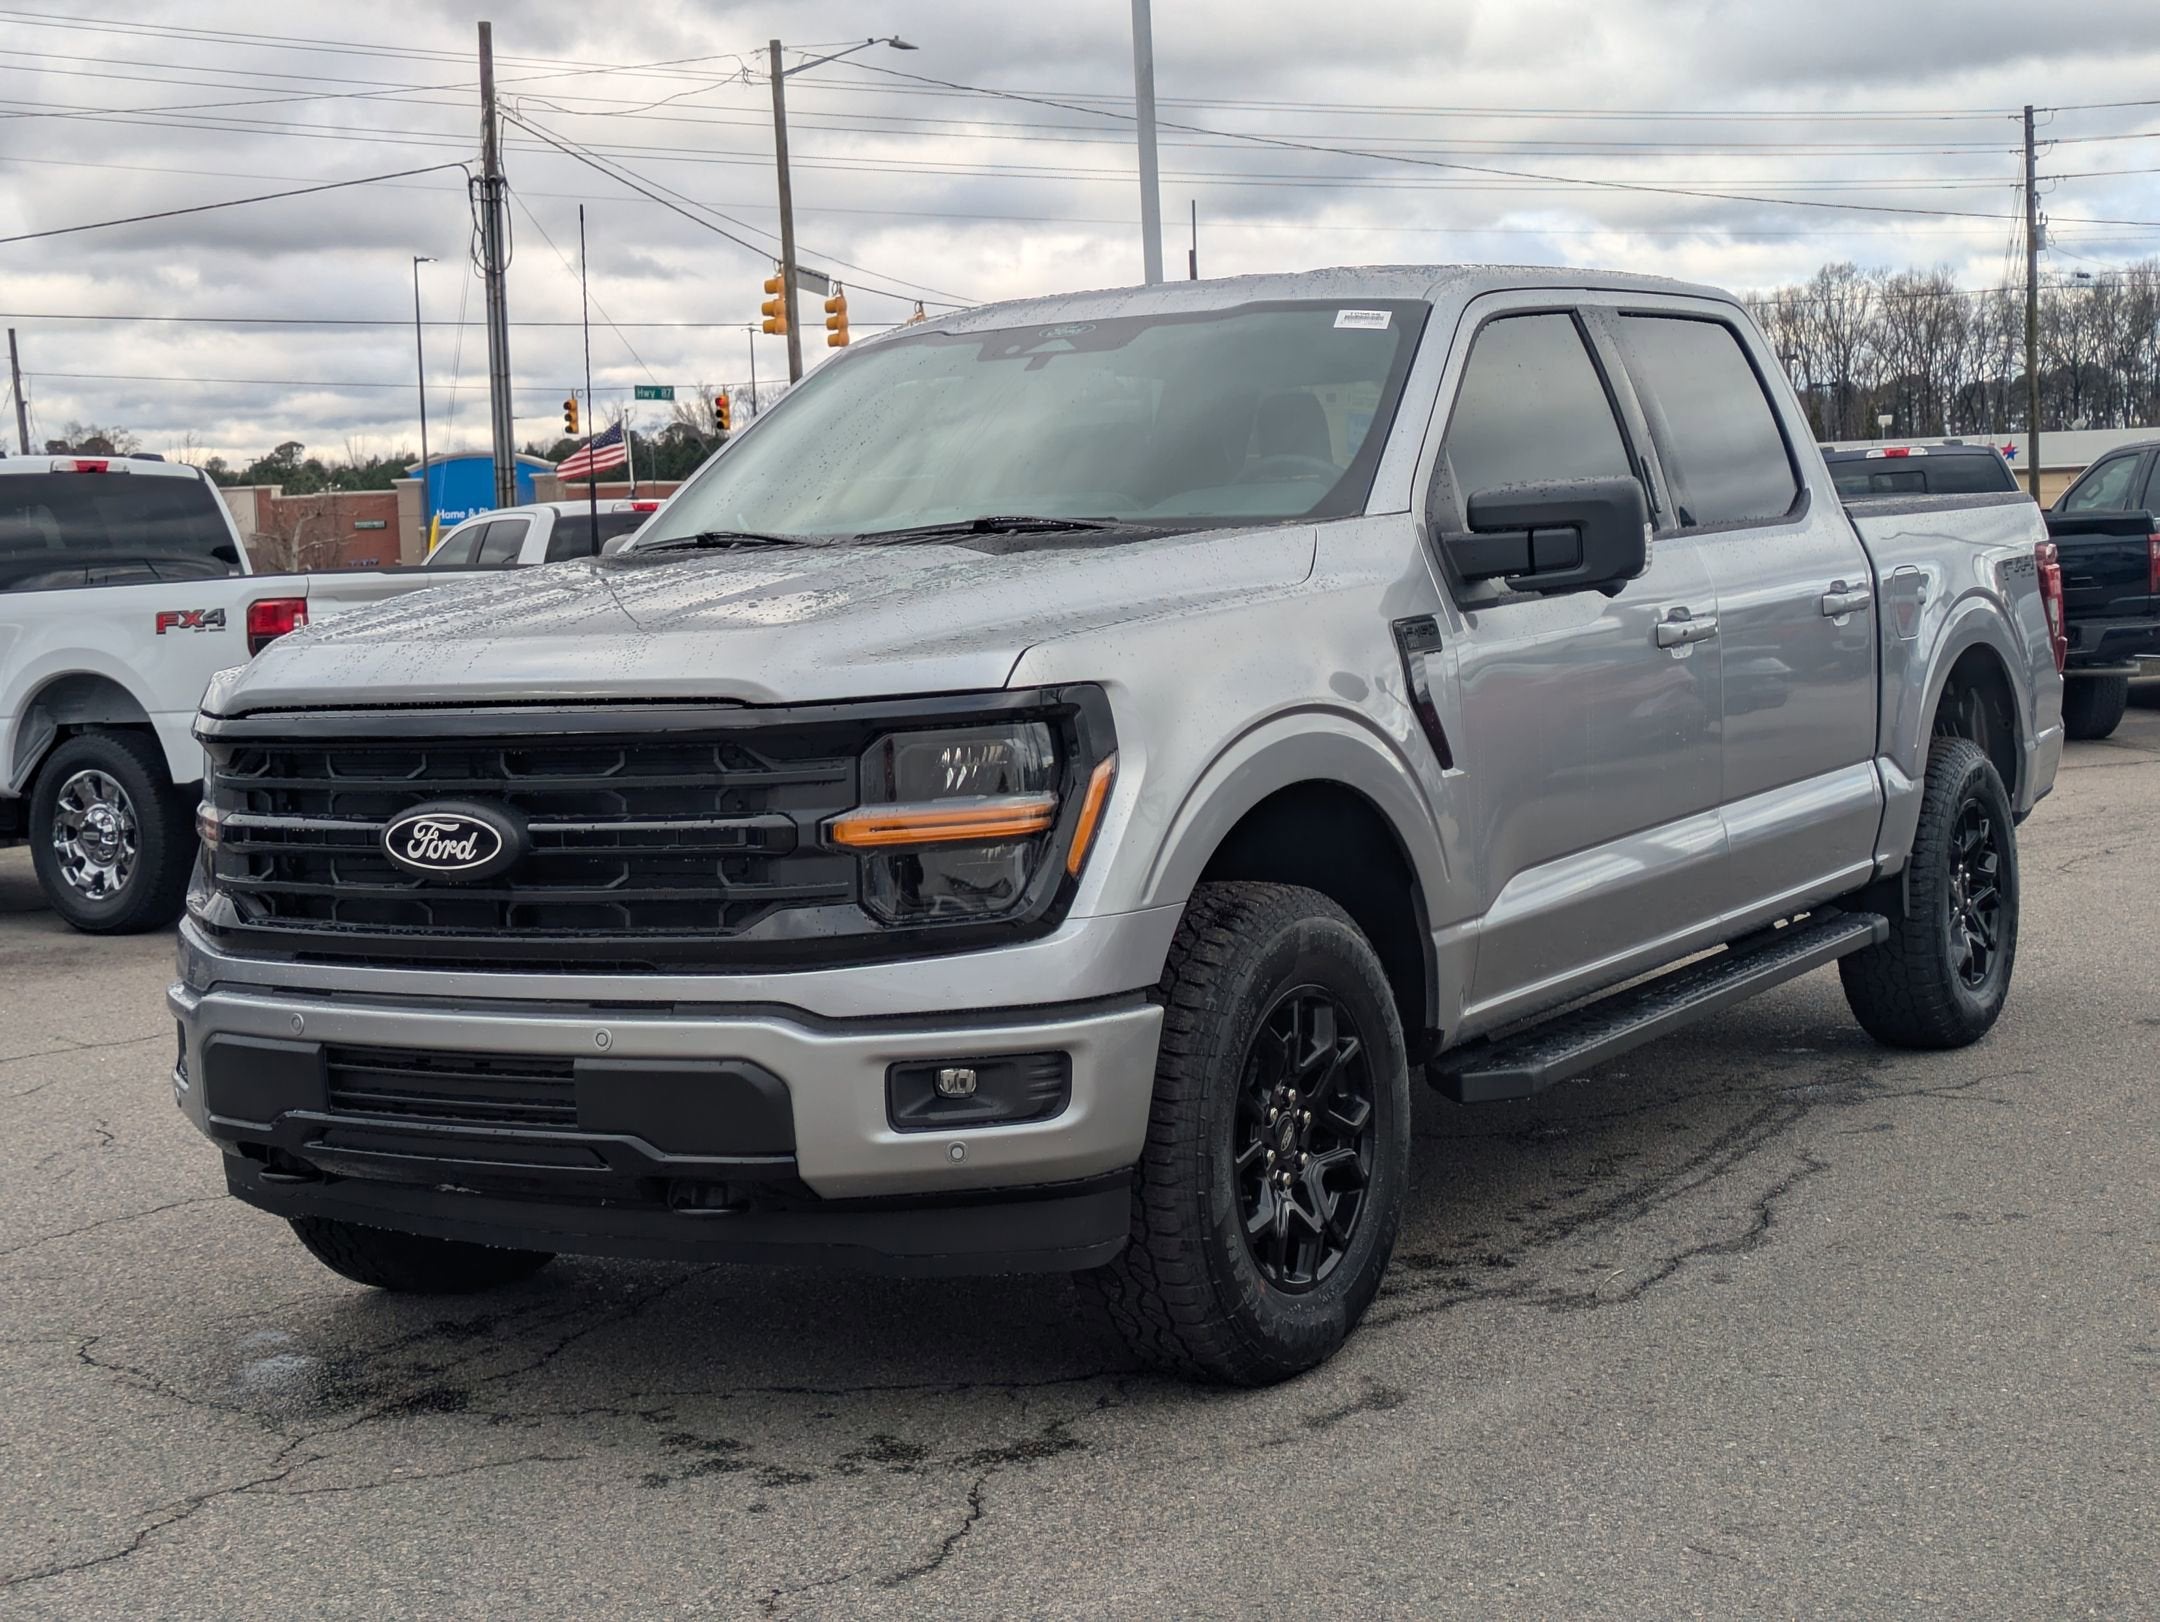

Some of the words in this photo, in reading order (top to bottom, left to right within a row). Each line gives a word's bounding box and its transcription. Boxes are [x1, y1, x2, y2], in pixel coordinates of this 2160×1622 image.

[637, 387, 656, 399] Hwy
[436, 508, 465, 520] Home
[156, 608, 226, 634] FX4
[407, 821, 478, 859] Ford
